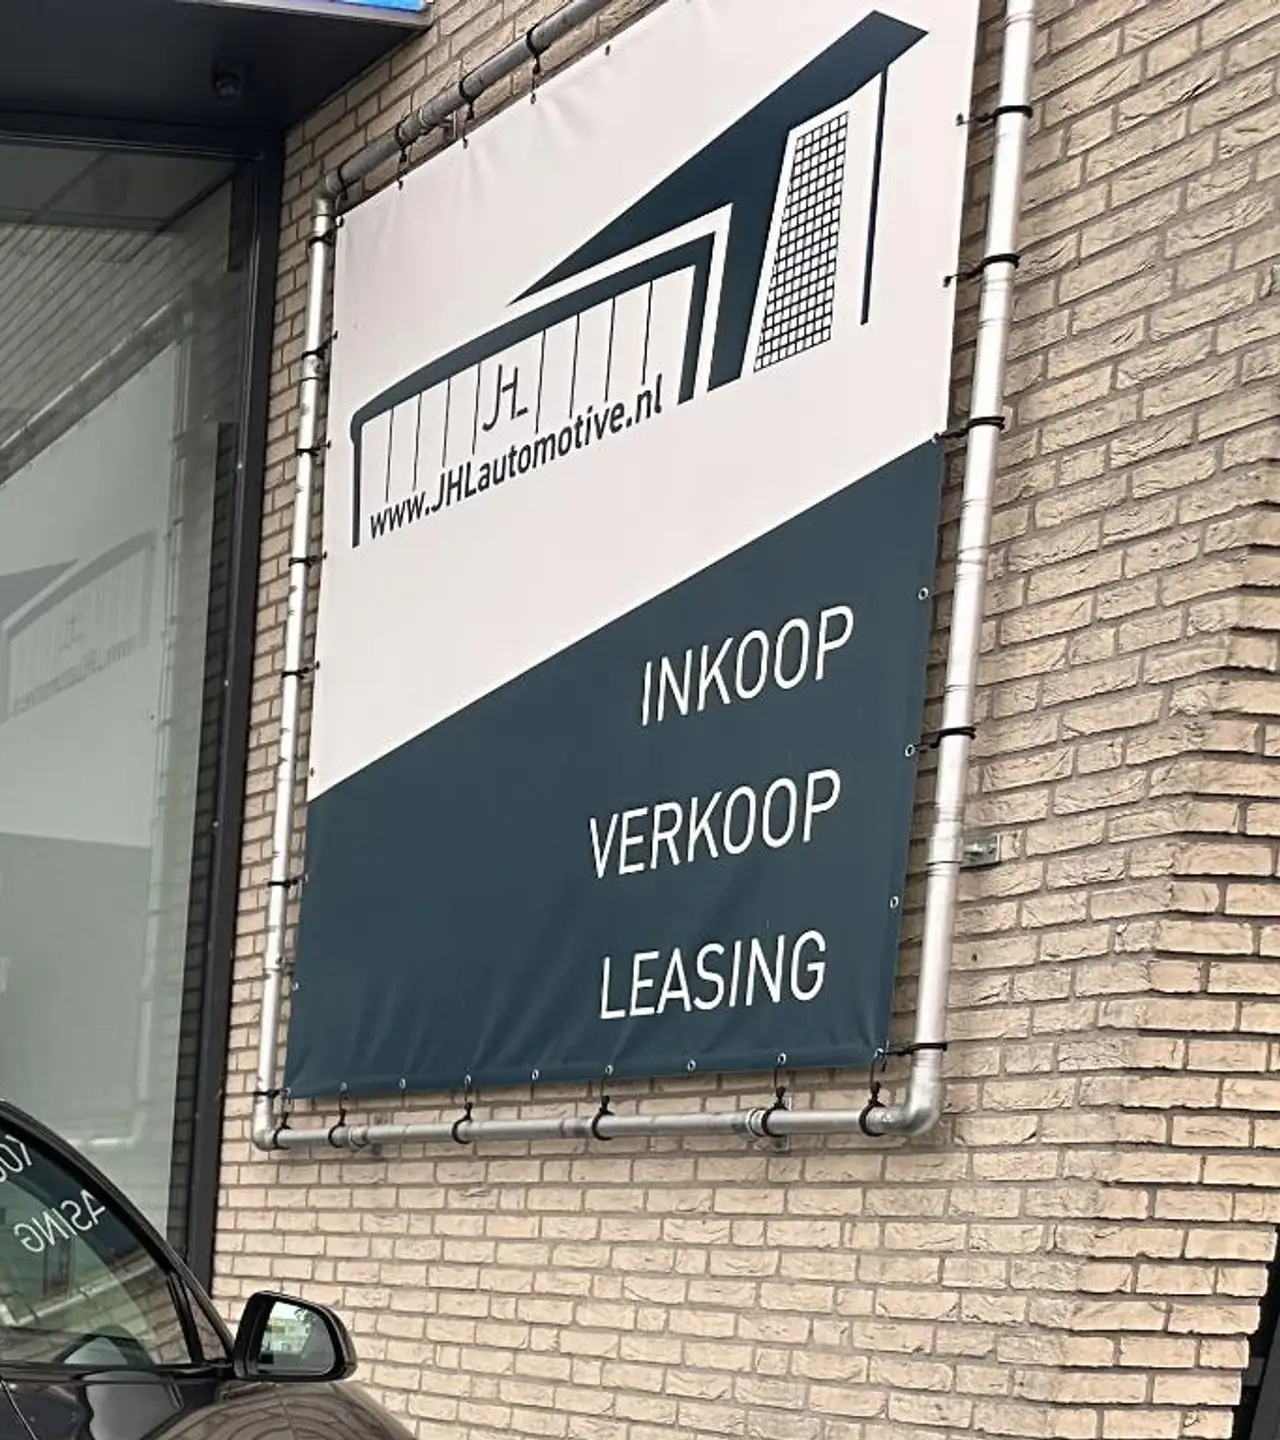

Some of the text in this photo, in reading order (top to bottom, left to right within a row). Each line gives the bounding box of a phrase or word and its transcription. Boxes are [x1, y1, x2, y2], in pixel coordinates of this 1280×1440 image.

[369, 373, 663, 539] www.JHLautomotive.nl
[640, 604, 855, 727] INKOOP
[588, 768, 841, 879] VERKOOP
[600, 929, 827, 1020] LEASING
